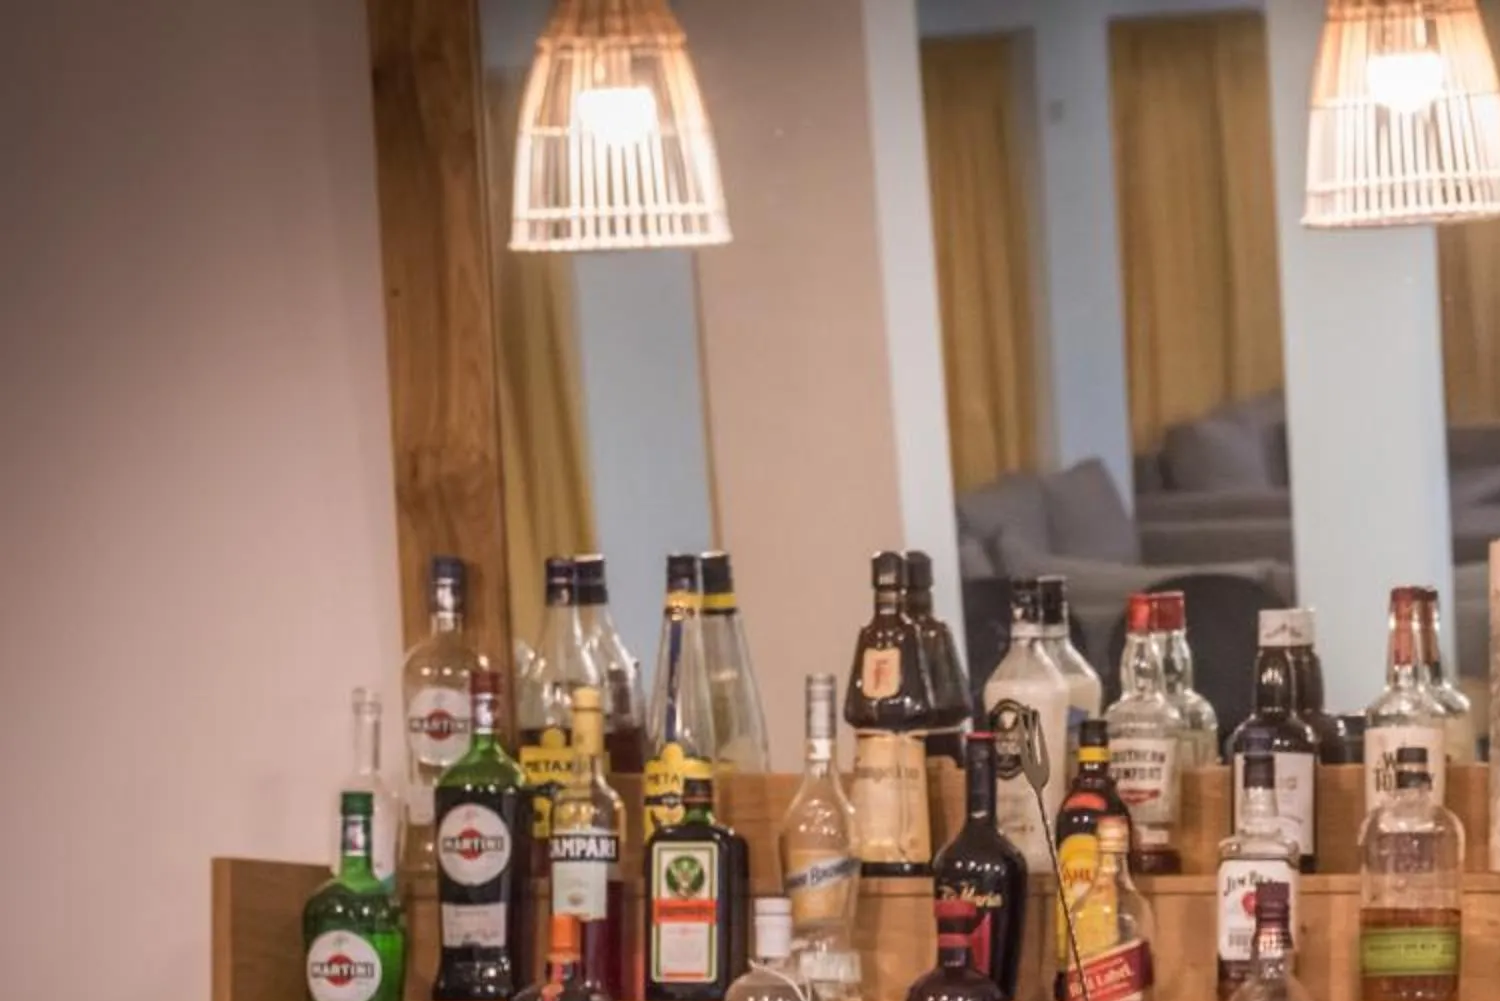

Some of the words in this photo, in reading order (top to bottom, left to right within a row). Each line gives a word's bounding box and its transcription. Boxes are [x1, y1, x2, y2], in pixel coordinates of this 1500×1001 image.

[525, 759, 573, 772] METAX
[442, 835, 505, 853] MARTINI
[311, 962, 375, 979] MARTINI
